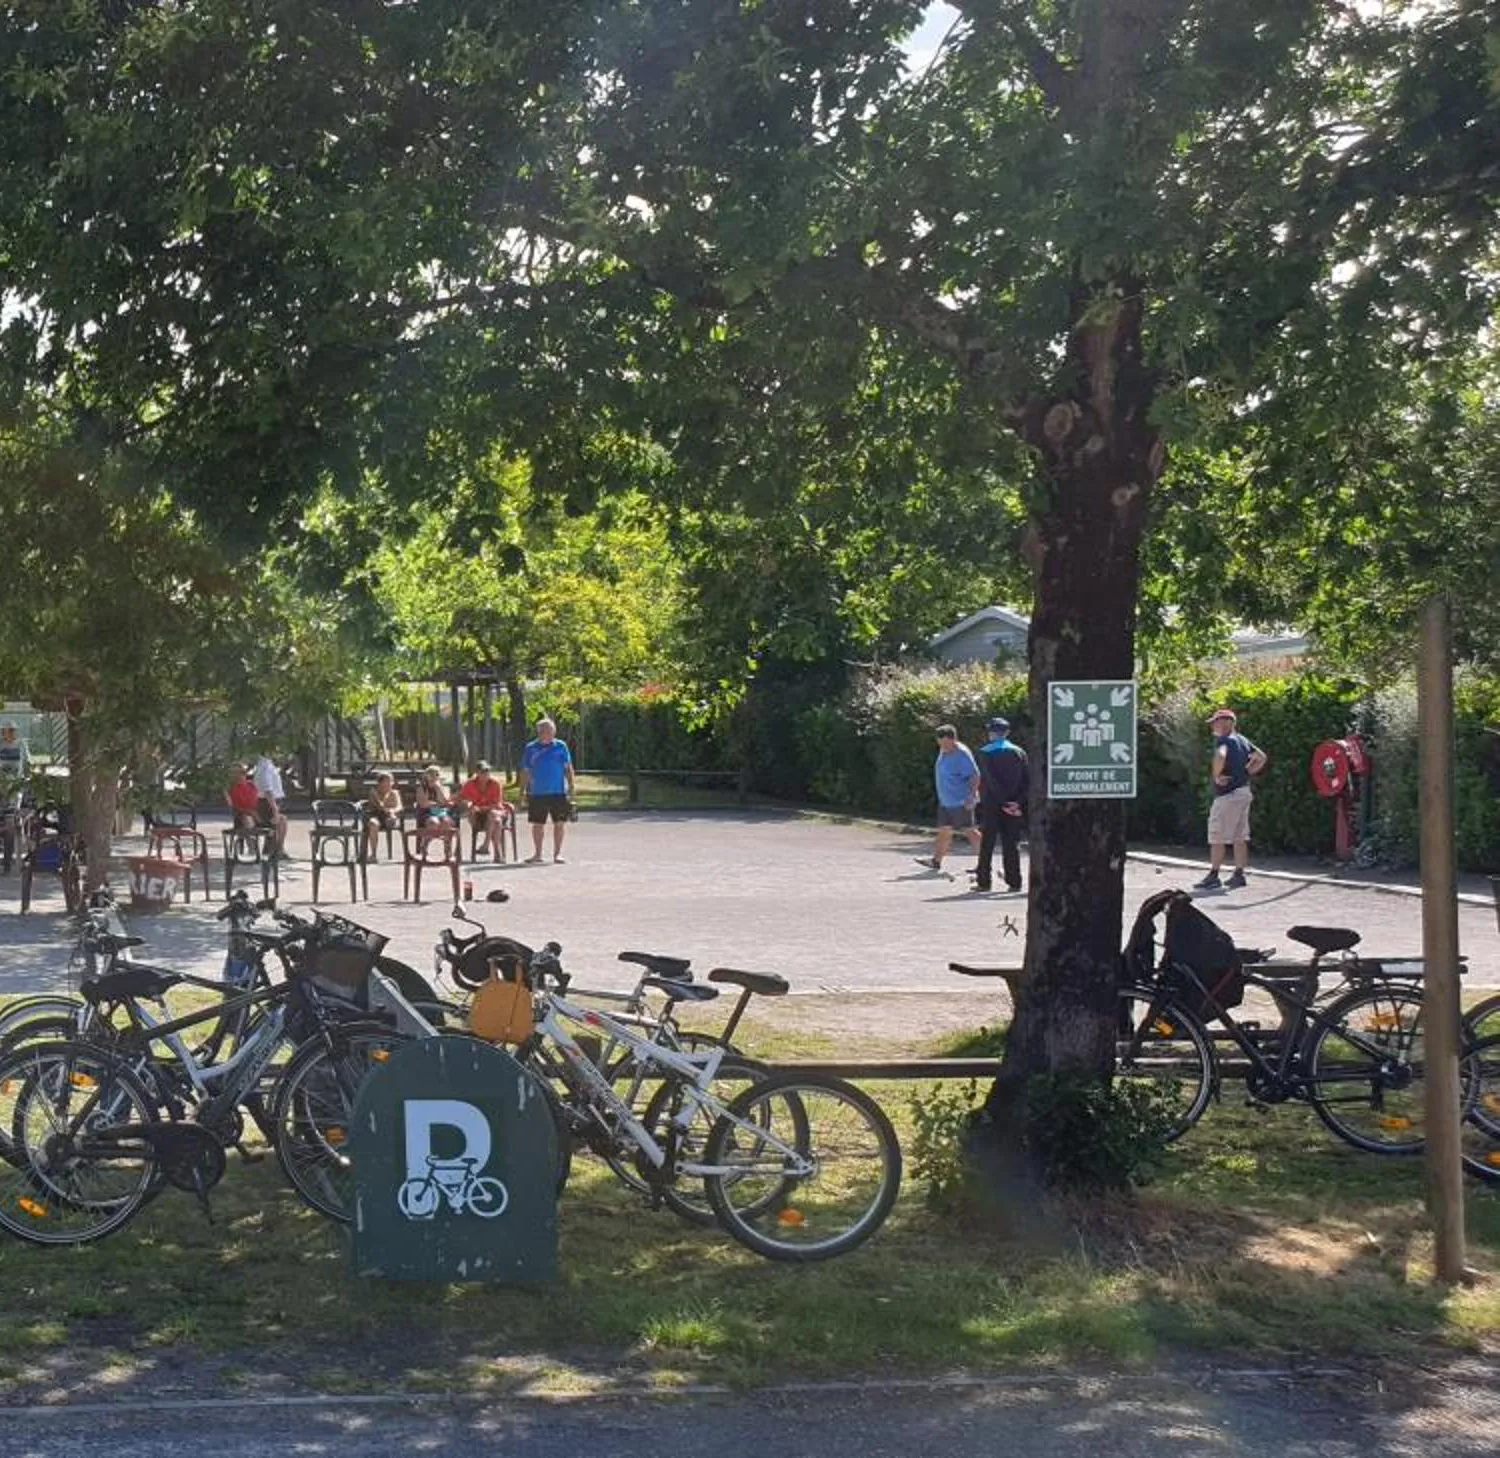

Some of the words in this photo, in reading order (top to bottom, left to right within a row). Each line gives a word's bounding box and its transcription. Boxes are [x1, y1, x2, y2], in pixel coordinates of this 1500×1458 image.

[1067, 770, 1100, 781] POINT
[1102, 770, 1117, 780] DE
[1053, 782, 1131, 793] RASSEMBLEMENT
[404, 1100, 491, 1219] P
